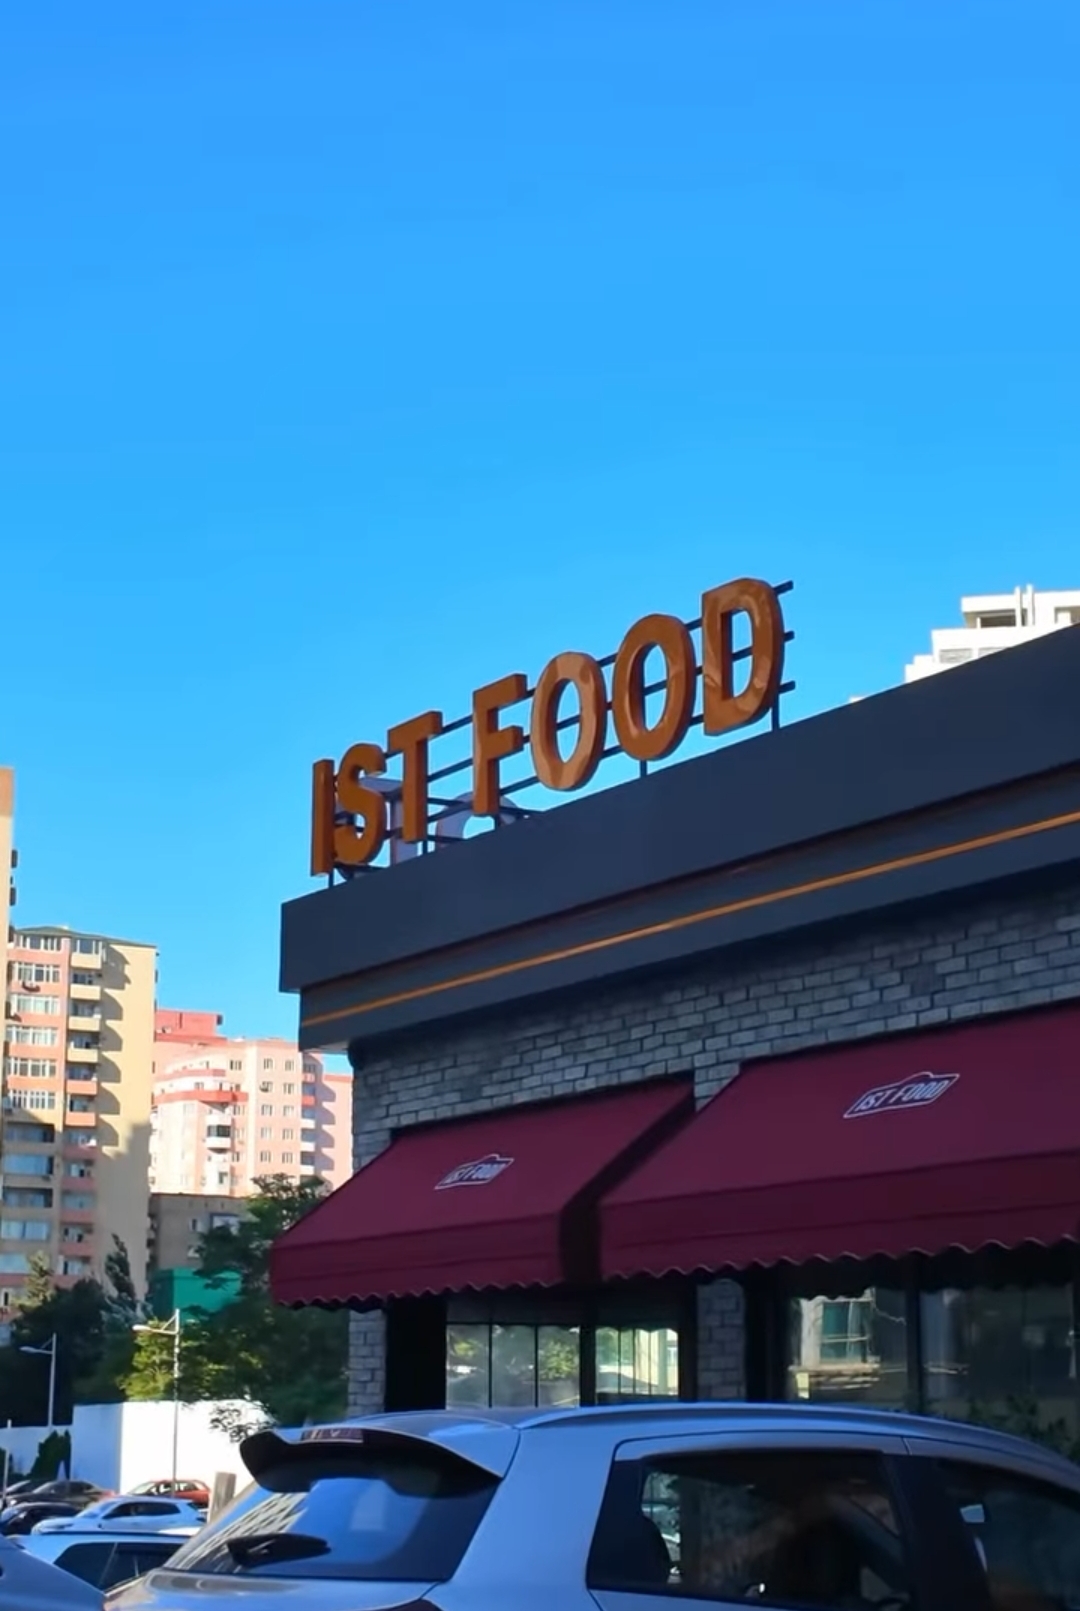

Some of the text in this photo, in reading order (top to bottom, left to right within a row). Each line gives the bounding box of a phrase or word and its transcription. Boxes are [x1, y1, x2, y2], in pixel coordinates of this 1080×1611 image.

[311, 710, 442, 876] IST
[472, 577, 784, 816] FOOD
[854, 1079, 949, 1112] IST FOOD
